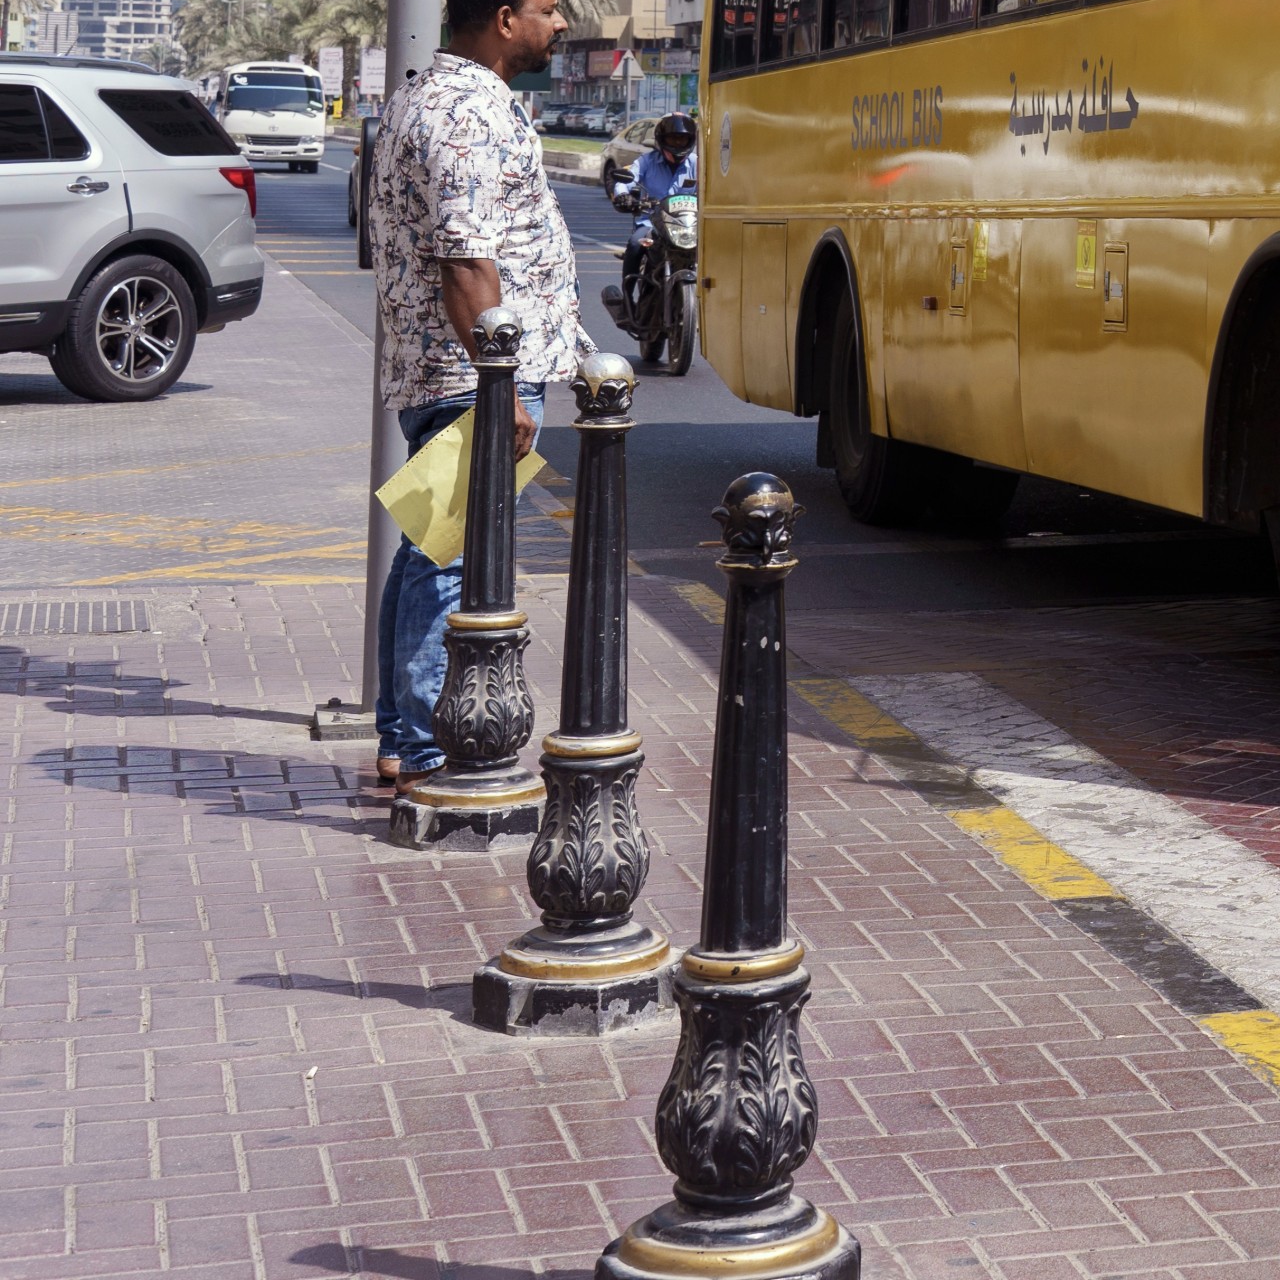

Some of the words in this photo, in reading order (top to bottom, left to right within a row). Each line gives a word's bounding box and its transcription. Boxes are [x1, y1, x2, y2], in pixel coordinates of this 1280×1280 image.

[850, 91, 909, 151] SCHOOL
[912, 85, 943, 147] BUS
[1008, 71, 1074, 157] مدرسية
[1078, 55, 1140, 134] حافلة
